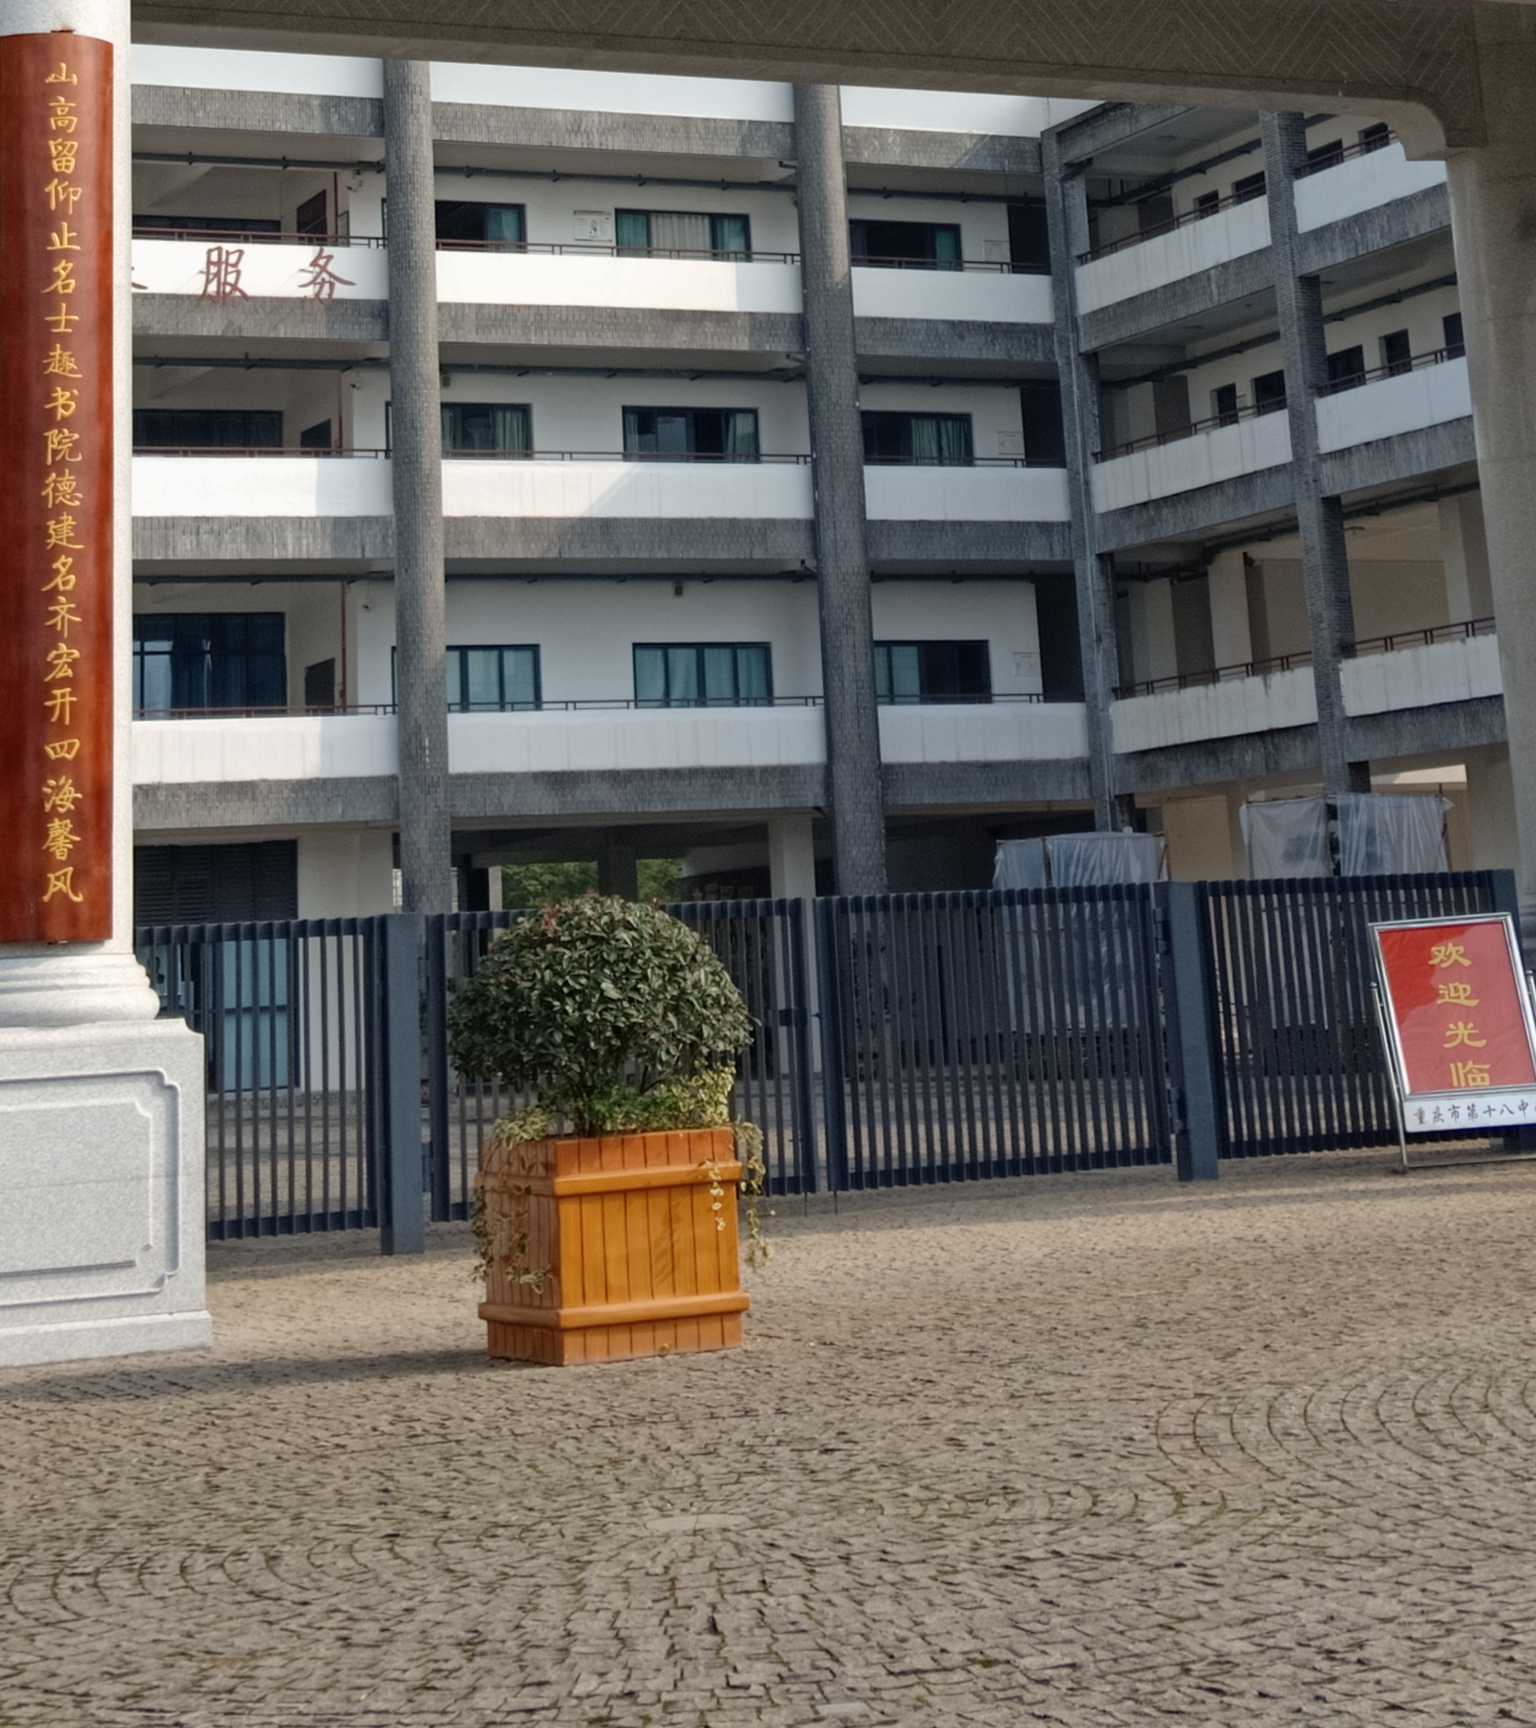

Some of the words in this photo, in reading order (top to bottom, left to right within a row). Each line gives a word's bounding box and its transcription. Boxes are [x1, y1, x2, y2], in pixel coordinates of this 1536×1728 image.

[132, 246, 357, 303] 服务
[1427, 942, 1491, 1087] 欢迎光临
